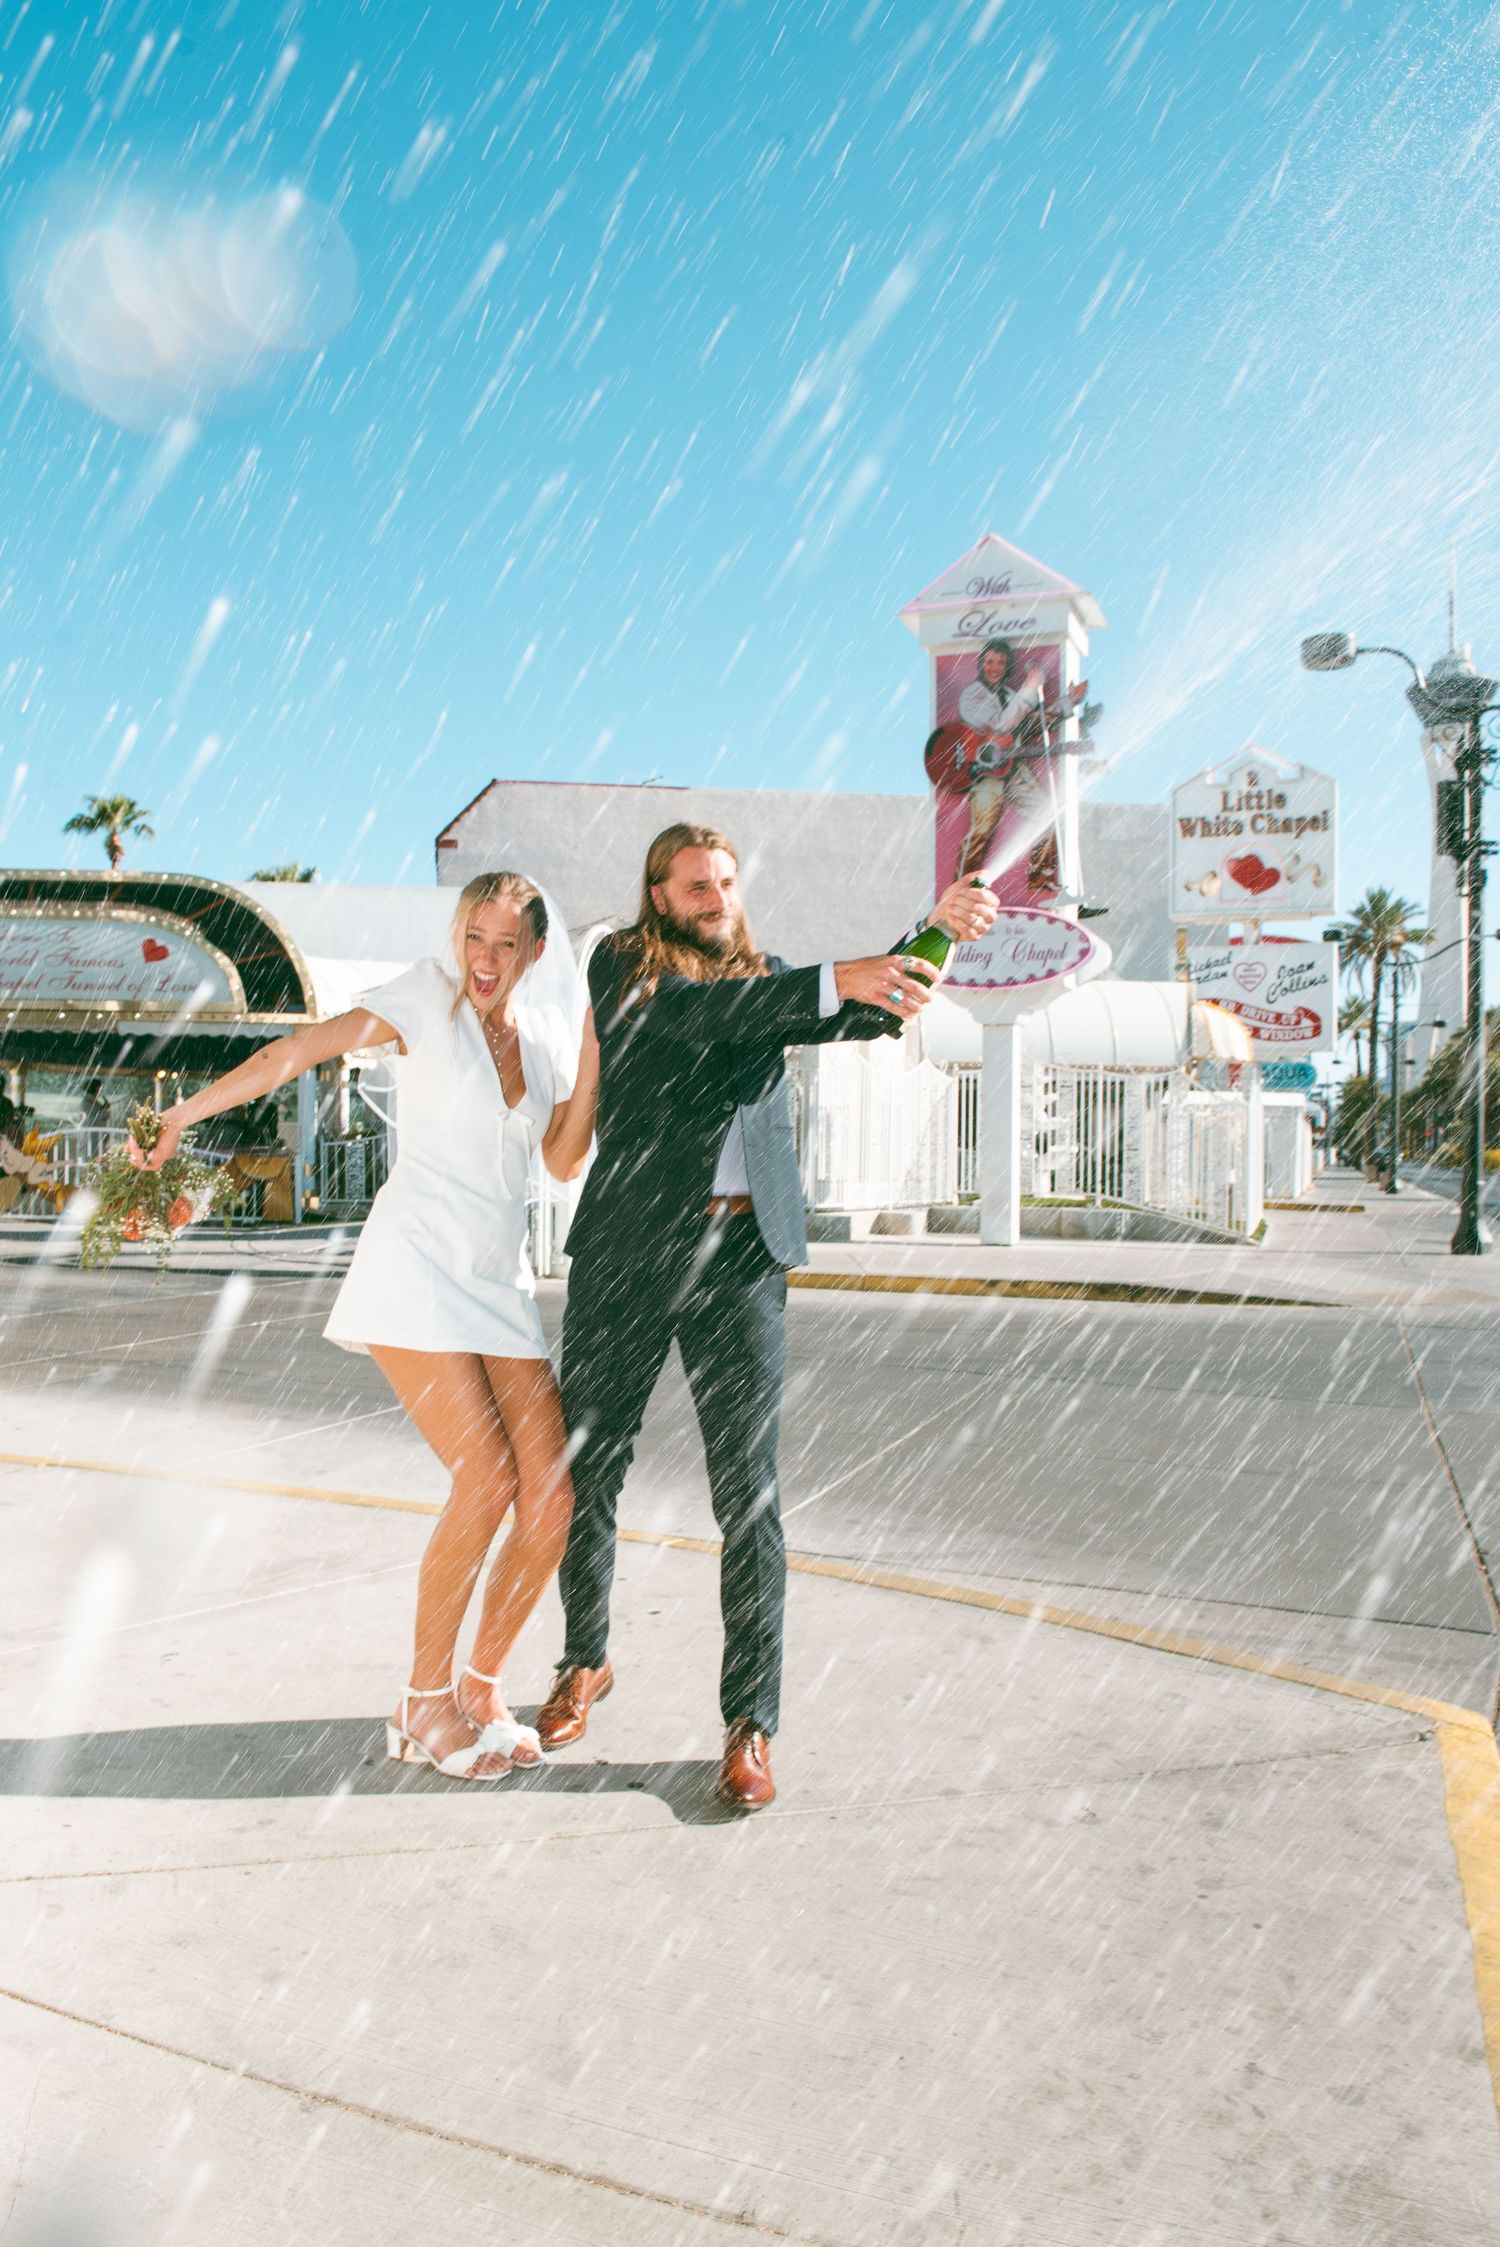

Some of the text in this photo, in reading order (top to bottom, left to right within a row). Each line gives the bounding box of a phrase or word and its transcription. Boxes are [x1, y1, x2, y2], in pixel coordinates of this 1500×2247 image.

[966, 570, 1014, 599] With
[952, 609, 1037, 638] Love
[1221, 788, 1287, 813] Little
[1177, 809, 1329, 839] White Chapel
[0, 947, 125, 968] orld Famous
[953, 937, 1068, 970] dding Chapel
[1189, 951, 1233, 974] ichael
[1277, 961, 1316, 980] Joan
[0, 972, 46, 997] hapel
[48, 970, 127, 991] Tunnel
[127, 975, 147, 999] of
[1266, 974, 1329, 1004] Collins
[1240, 1003, 1277, 1024] DRIVE
[1281, 1014, 1299, 1026] UP
[1259, 1027, 1313, 1041] WINDOW
